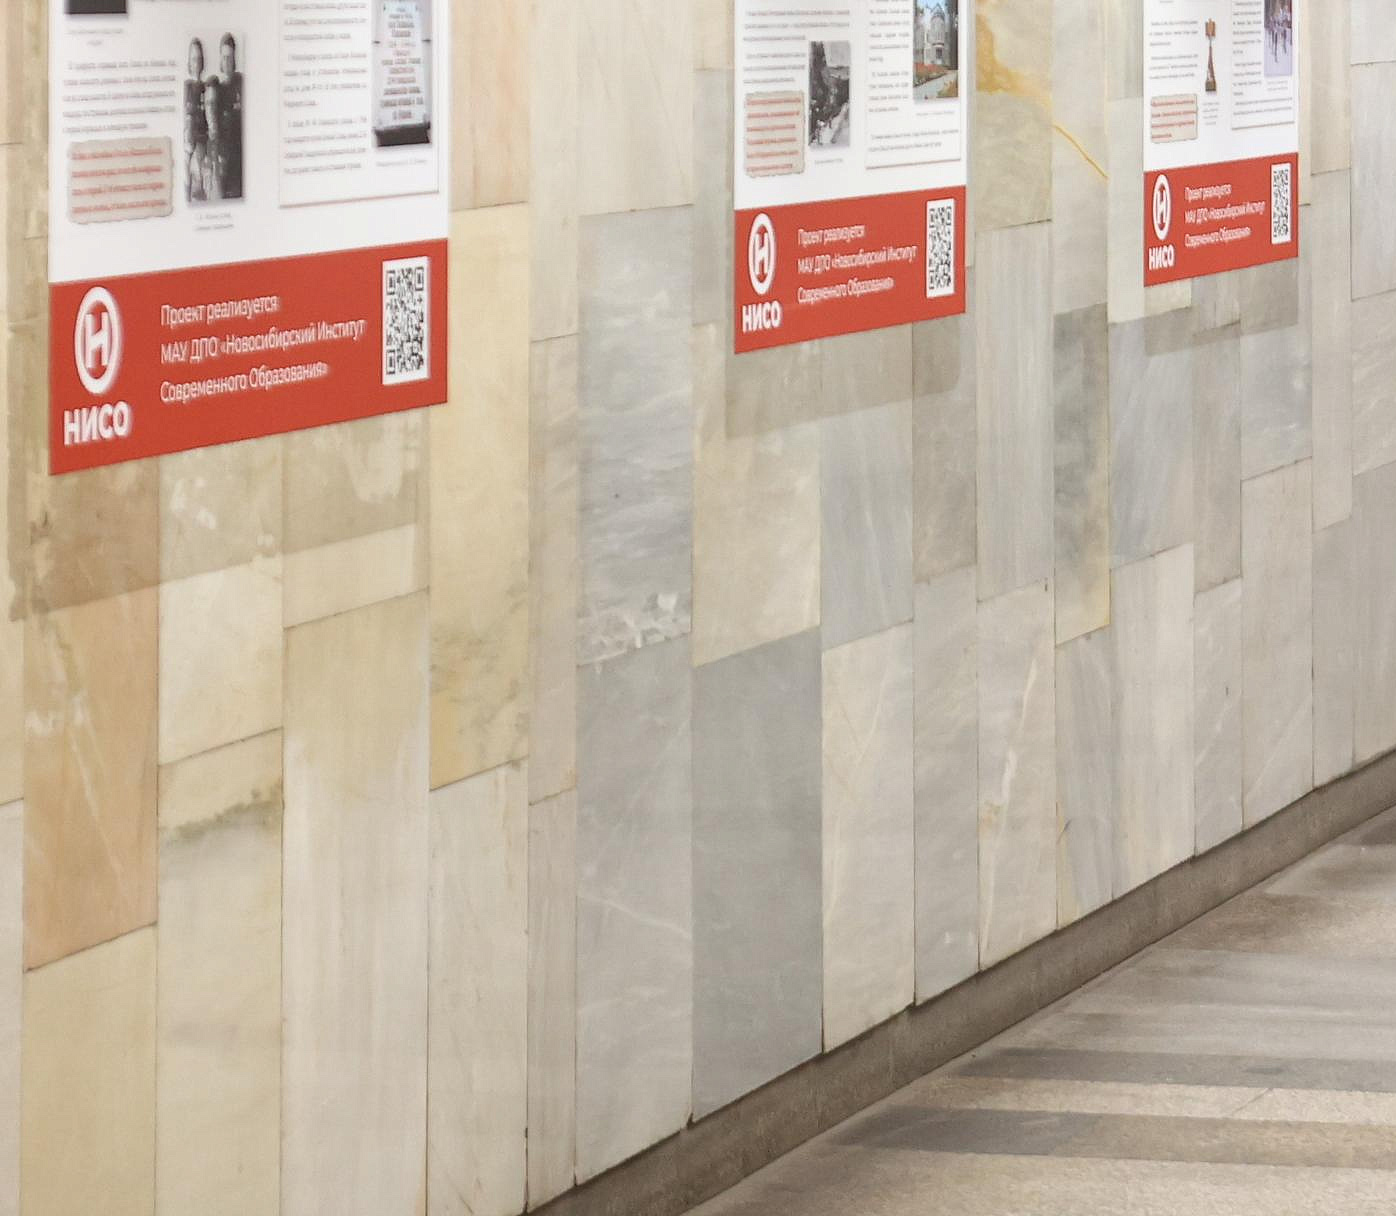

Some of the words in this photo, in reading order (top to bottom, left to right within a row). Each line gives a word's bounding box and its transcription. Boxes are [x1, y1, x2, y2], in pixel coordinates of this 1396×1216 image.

[1149, 244, 1175, 270] НИСО
[161, 303, 205, 329] Проект
[206, 295, 279, 324] реализуется
[742, 300, 782, 333] НИСО
[161, 340, 188, 364] МАУ
[189, 336, 219, 364] ДПО
[316, 319, 367, 341] Институт
[160, 372, 247, 404] Современного
[249, 361, 328, 390] Образования»
[63, 401, 131, 447] НИСО
